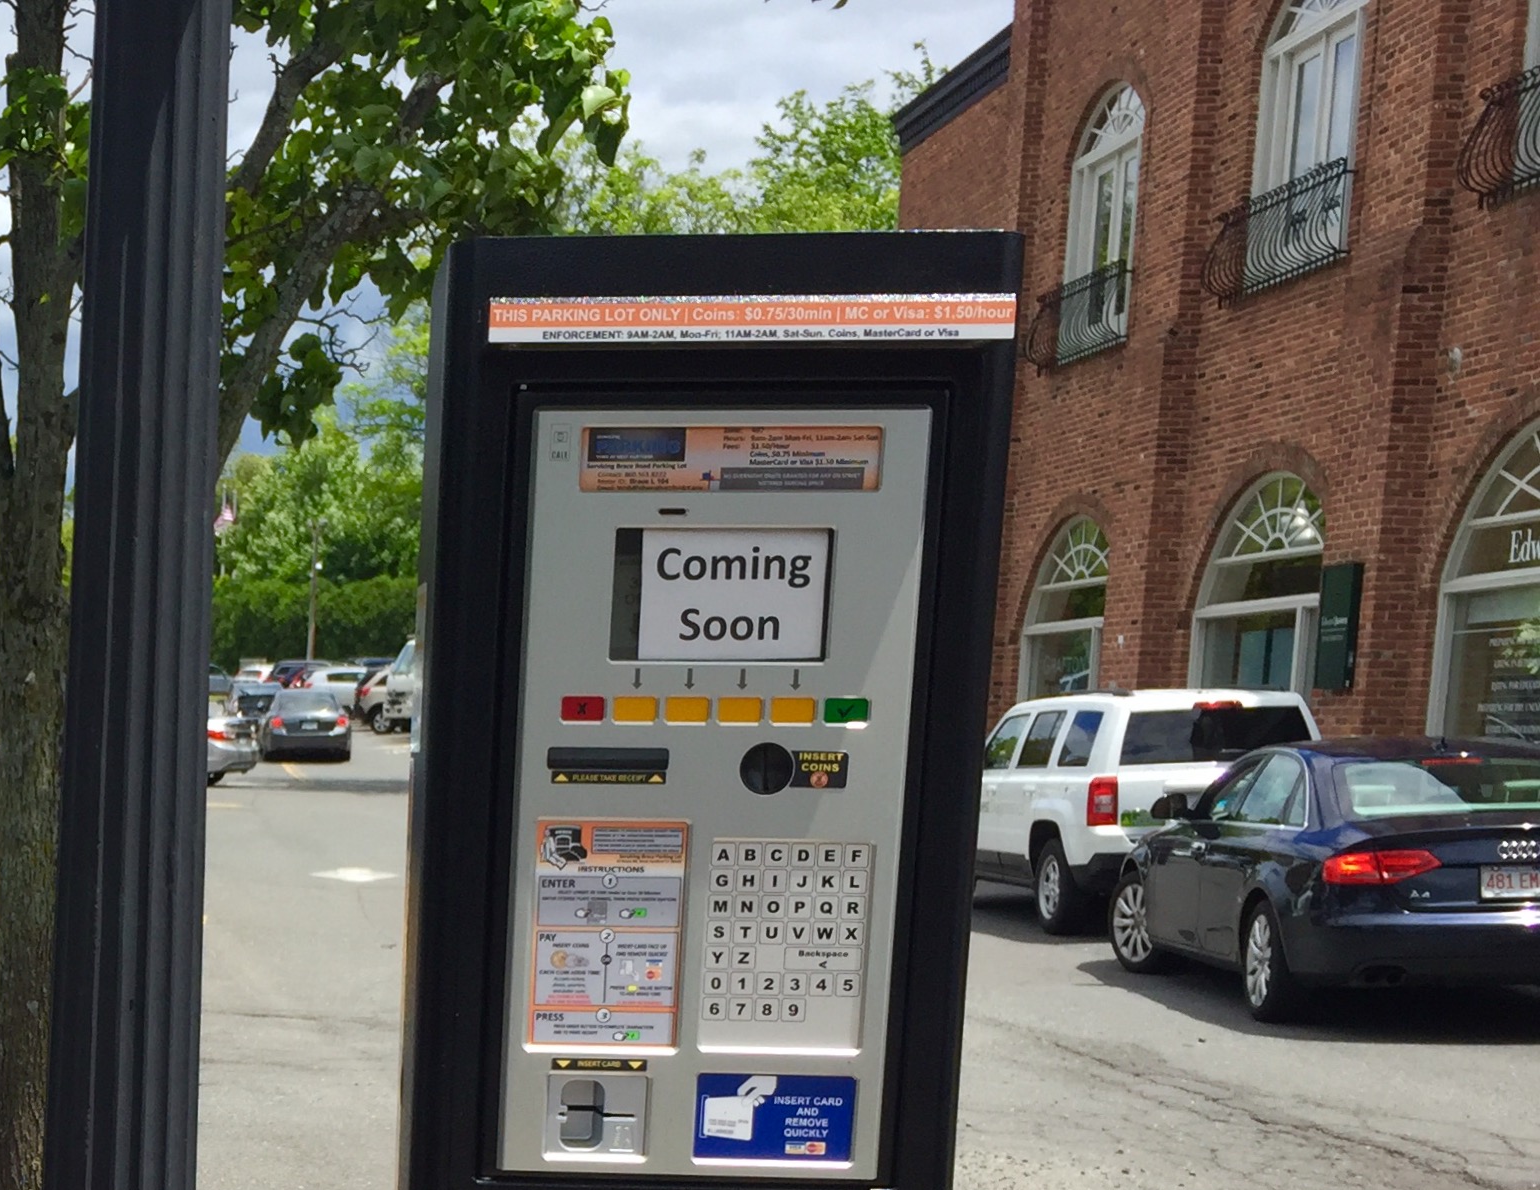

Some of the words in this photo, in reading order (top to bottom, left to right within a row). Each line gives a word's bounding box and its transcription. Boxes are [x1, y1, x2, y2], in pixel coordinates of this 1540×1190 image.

[494, 309, 527, 322] THIS
[532, 308, 600, 322] PARKING
[605, 308, 635, 321] LOT
[640, 308, 681, 321] ONLY
[692, 308, 740, 320] Coins:
[745, 307, 832, 321] $0.75/30min
[845, 307, 868, 319] MC
[873, 310, 889, 319] or
[894, 306, 930, 319] Visa:
[934, 306, 1013, 319] $1.50/hour
[543, 331, 624, 340] ENFORCEMENT:
[627, 330, 677, 340] 9AM-2AM,
[680, 330, 721, 339] Mon-Fri;
[725, 330, 780, 339] 11AM-2AM,
[783, 329, 825, 338] Sat-Sun.
[828, 329, 859, 338] Coins,
[864, 329, 921, 337] MasterCard
[938, 328, 960, 337] Visa
[657, 546, 812, 588] Coming
[679, 608, 780, 640] Soon
[799, 752, 843, 762] INSERT
[801, 762, 839, 772] COINS
[717, 849, 729, 861] A
[745, 849, 756, 861] B
[771, 849, 782, 861] C
[798, 850, 809, 861] D
[825, 850, 835, 862] E
[852, 850, 861, 862] F
[542, 879, 576, 888] ENTER
[716, 875, 728, 887] G
[743, 875, 754, 887] H
[797, 876, 807, 888] J
[822, 876, 834, 888] K
[850, 876, 859, 888] L
[1487, 874, 1514, 889] 481
[1410, 890, 1430, 898] A4
[714, 901, 728, 912] M
[741, 901, 753, 913] N
[767, 901, 780, 913] O
[795, 901, 805, 913] P
[820, 902, 832, 914] Q
[847, 902, 858, 914] R
[714, 926, 724, 938] S
[740, 926, 751, 938] T
[766, 927, 778, 939] U
[793, 927, 804, 939] V
[817, 928, 833, 939] W
[845, 928, 857, 940] X
[713, 952, 723, 963] Y
[738, 952, 749, 964] Z
[711, 977, 721, 989] 0
[764, 978, 774, 990] 2
[790, 978, 800, 991] 3
[816, 979, 826, 990] 4
[843, 979, 853, 991] 5
[774, 1096, 811, 1105] INSERT
[814, 1096, 843, 1106] CARD
[796, 1107, 819, 1116] AND
[785, 1118, 828, 1127] REMOVE
[784, 1128, 828, 1138] QUICKLY
